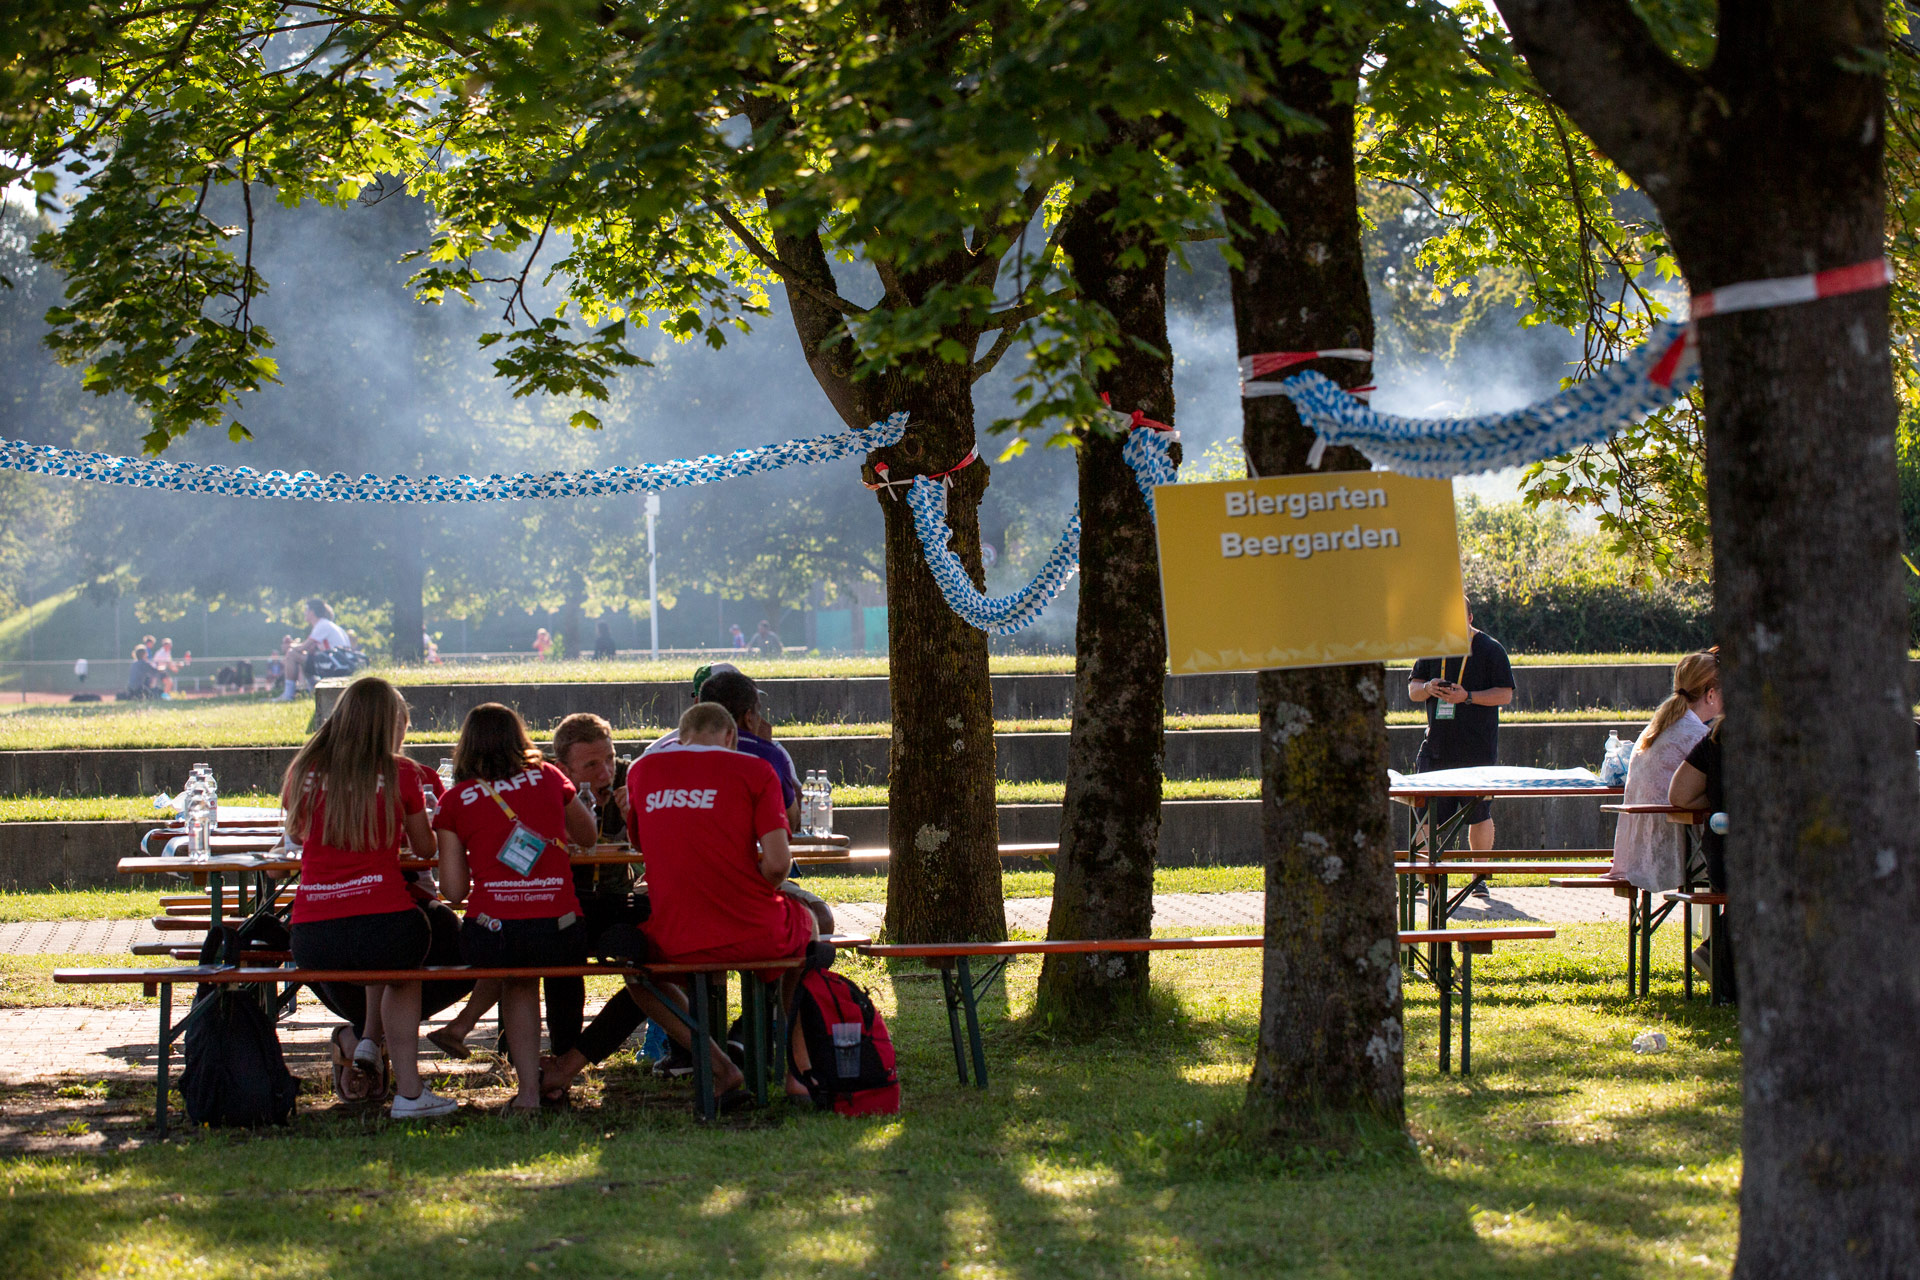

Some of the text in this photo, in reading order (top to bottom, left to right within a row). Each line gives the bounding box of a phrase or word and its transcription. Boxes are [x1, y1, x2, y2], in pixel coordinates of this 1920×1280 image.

[1225, 486, 1388, 518] Biergarten
[1220, 524, 1400, 559] Beergarden
[460, 769, 543, 805] STAFF
[494, 893, 520, 902] Munich
[524, 893, 556, 903] Germany
